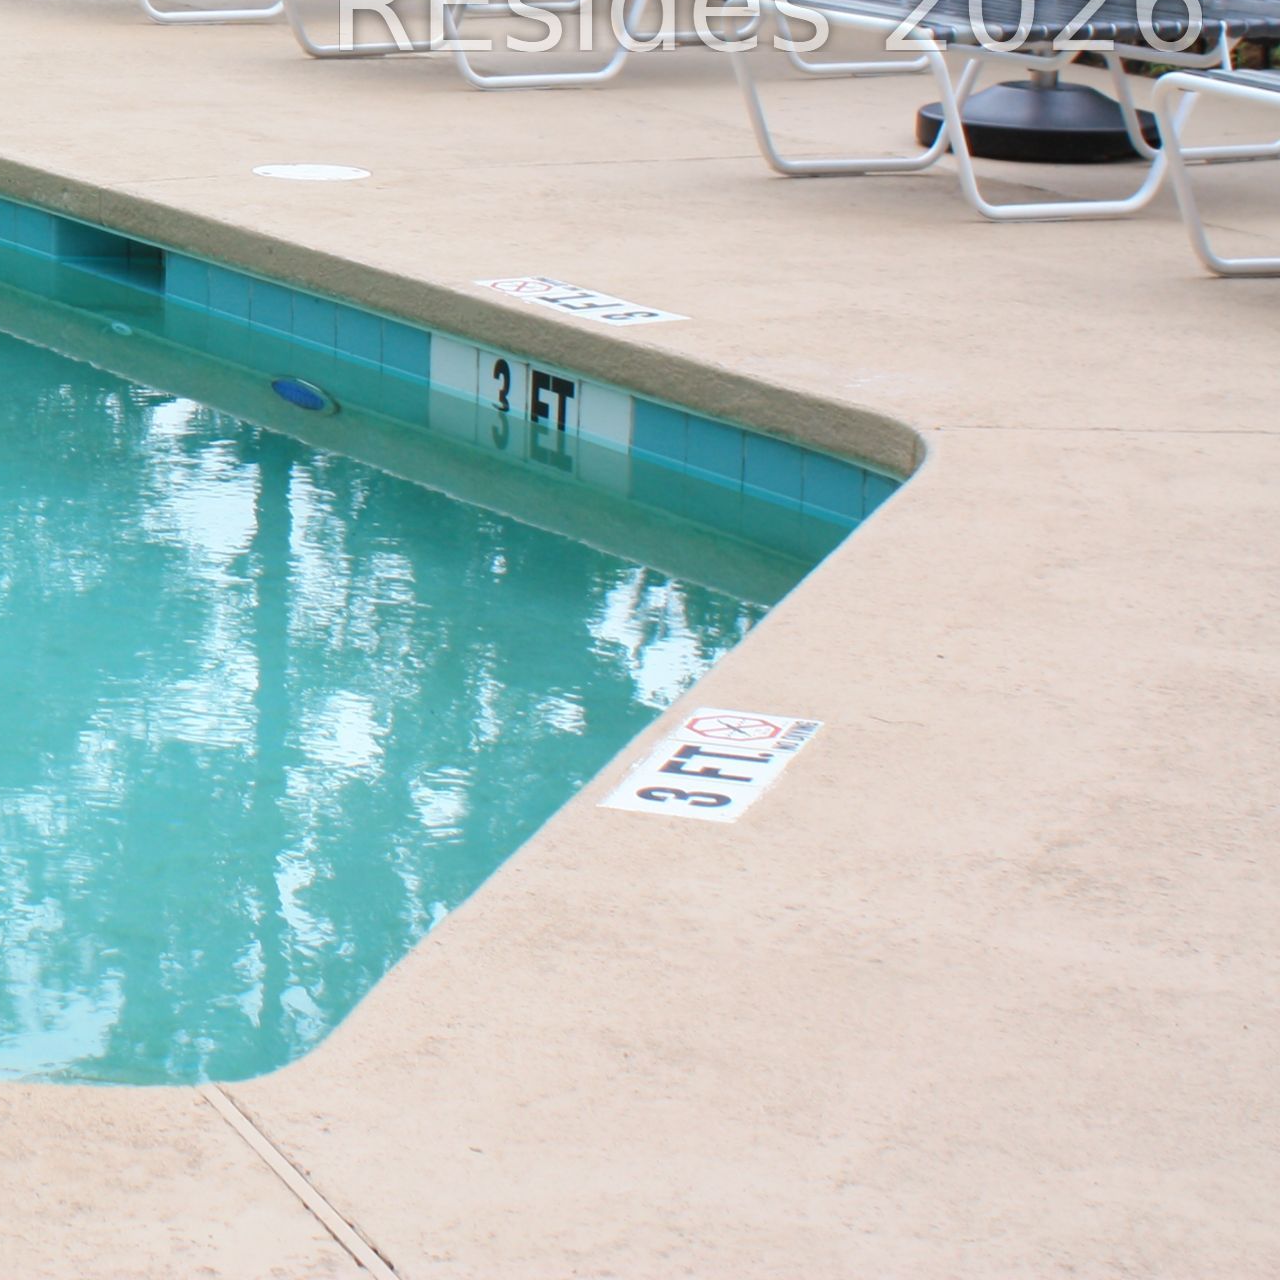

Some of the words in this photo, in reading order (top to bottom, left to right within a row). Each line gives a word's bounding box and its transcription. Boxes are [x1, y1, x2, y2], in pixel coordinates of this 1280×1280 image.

[493, 358, 511, 412] 3
[532, 369, 576, 432] FT
[658, 744, 775, 783] FT.
[636, 786, 733, 808] 3
